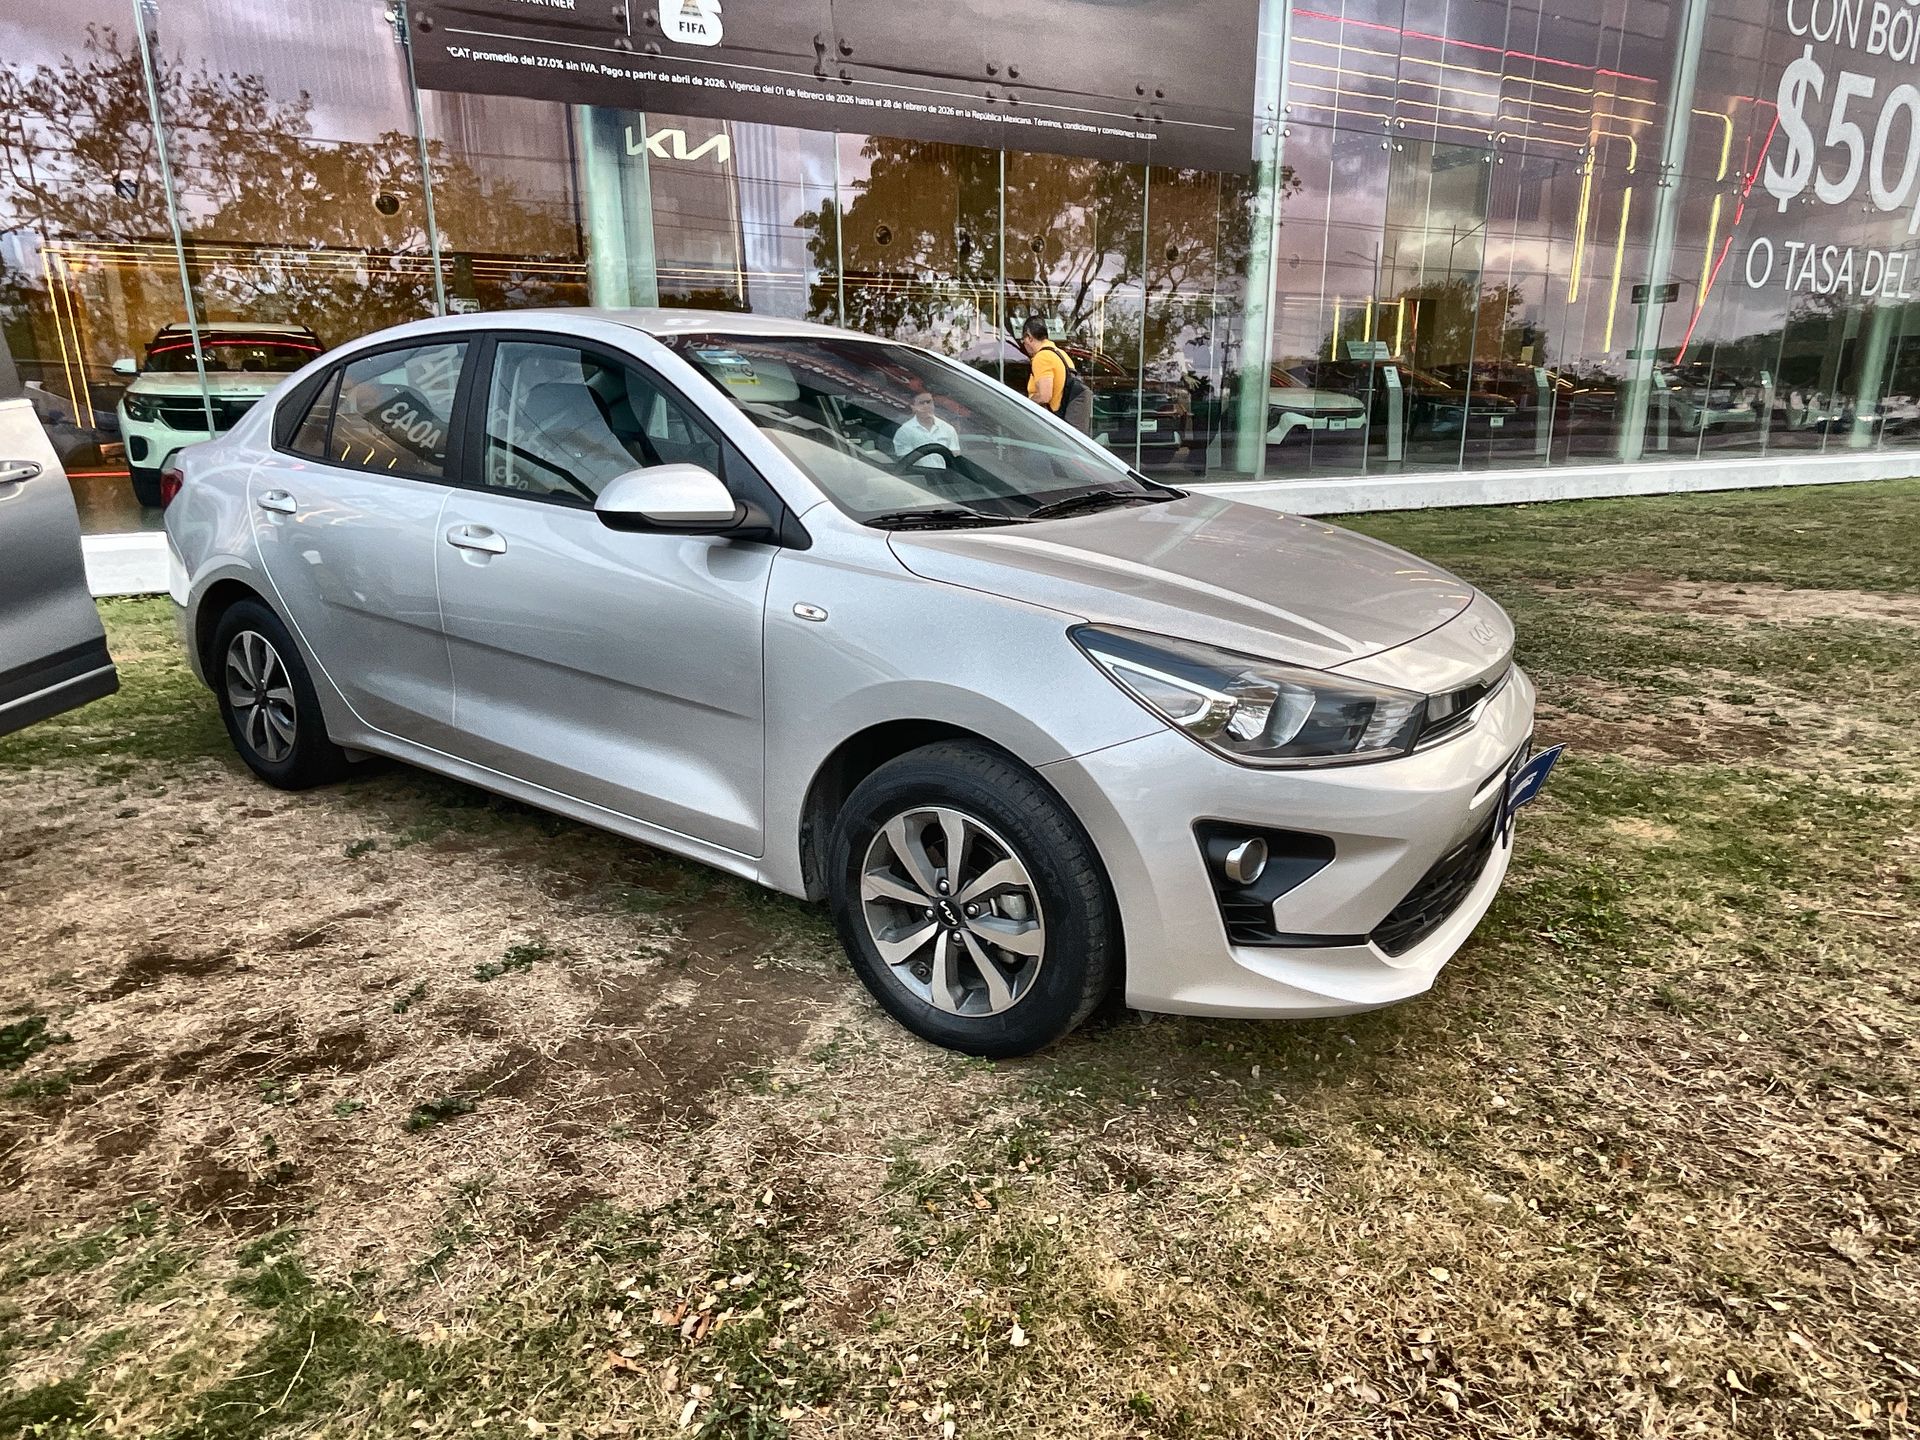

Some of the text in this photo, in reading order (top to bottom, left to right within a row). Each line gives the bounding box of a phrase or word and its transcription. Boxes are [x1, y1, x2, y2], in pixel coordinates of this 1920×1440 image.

[679, 21, 707, 35] FIFA
[1787, 0, 1862, 48] CON
[472, 51, 518, 64] promedio
[520, 55, 535, 66] del
[536, 57, 563, 70] 27.0%
[565, 61, 578, 71] sin
[580, 63, 599, 74] IVA.
[600, 65, 623, 78] Pago
[624, 69, 631, 77] a
[632, 71, 656, 82] partir
[658, 72, 669, 82] de
[671, 74, 690, 84] abril
[691, 76, 702, 86] de
[703, 78, 727, 89] 2026.
[728, 80, 760, 93] Vigencia
[762, 85, 774, 94] del
[775, 85, 784, 96] 01
[785, 87, 795, 97] de
[796, 89, 824, 101] febrero
[825, 92, 835, 103] de
[836, 94, 854, 104] 2026
[855, 96, 874, 106] hasta
[875, 98, 882, 107] el
[882, 98, 892, 108] 28
[892, 100, 902, 109] de
[902, 102, 927, 112] febrero
[927, 104, 937, 114] de
[937, 106, 954, 116] 2026
[955, 108, 964, 117] en
[964, 108, 971, 118] la
[971, 110, 1001, 122] República
[625, 126, 731, 163] KIA
[1746, 237, 1912, 299] O TASA DEL
